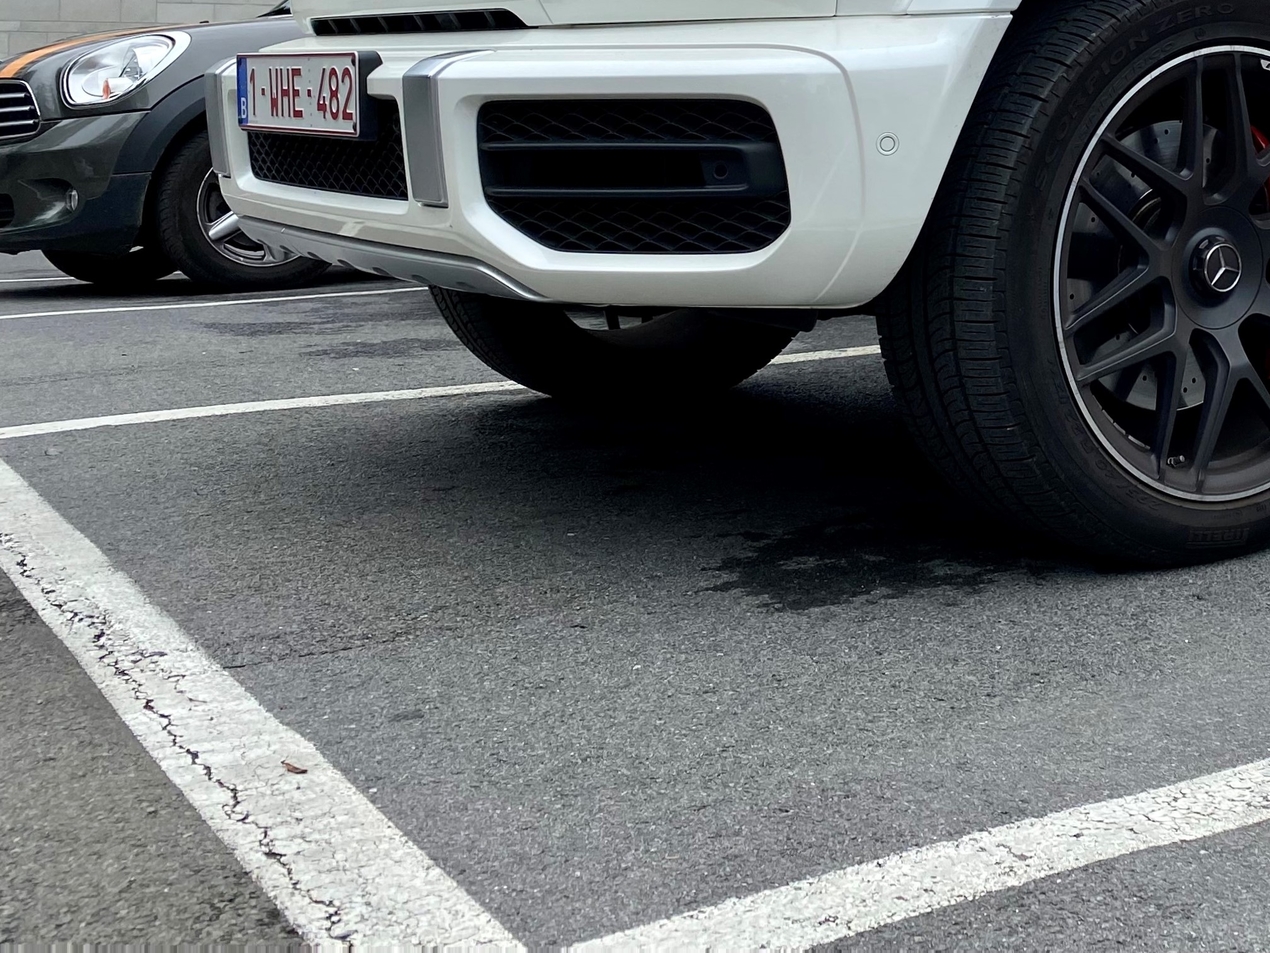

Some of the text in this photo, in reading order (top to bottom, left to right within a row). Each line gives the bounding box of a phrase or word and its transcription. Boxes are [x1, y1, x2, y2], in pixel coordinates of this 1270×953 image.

[1153, 1, 1235, 35] ZERO
[240, 97, 248, 119] B
[249, 66, 354, 121] 1-WHE-482
